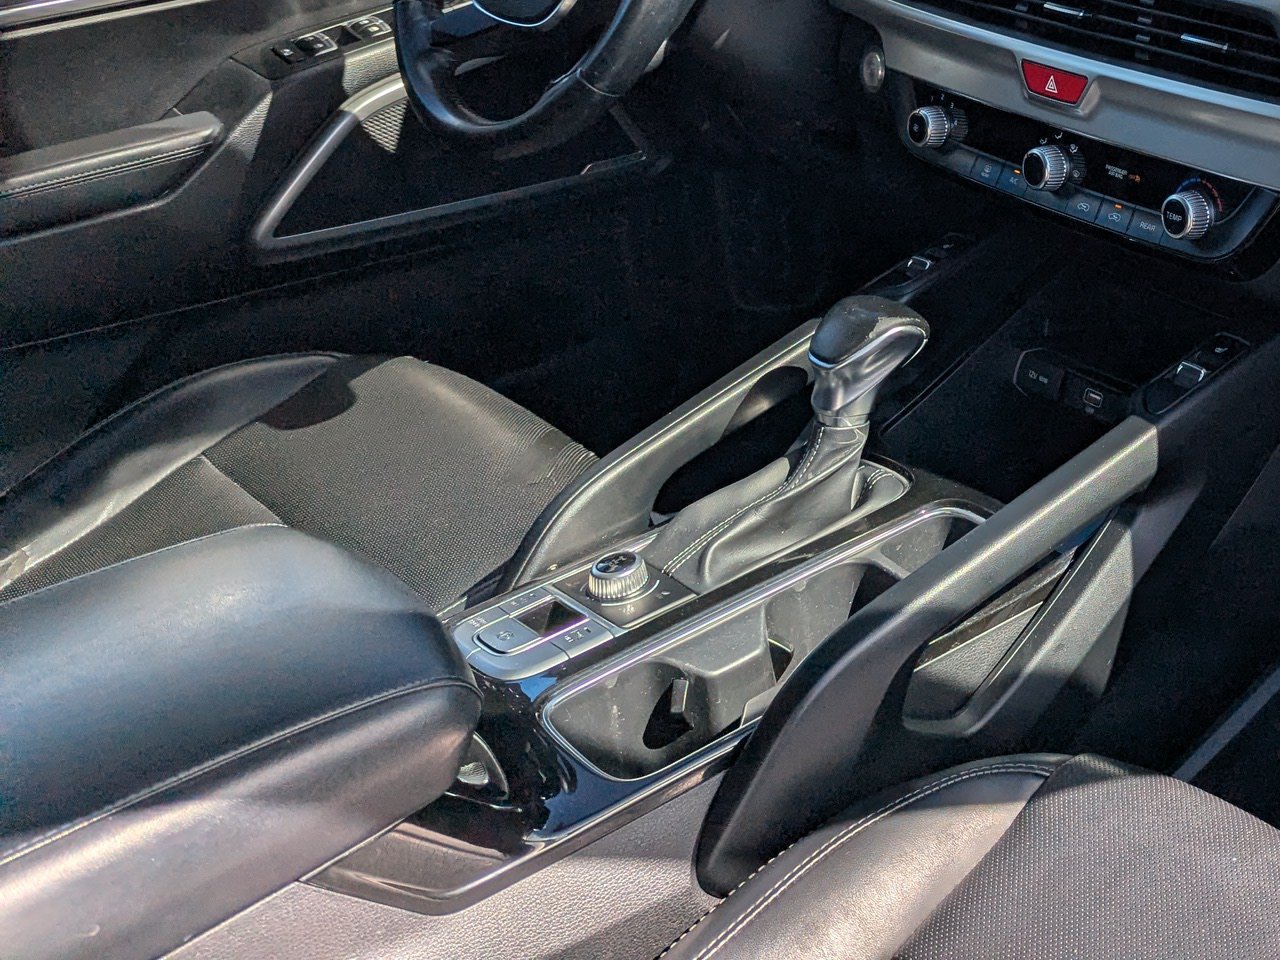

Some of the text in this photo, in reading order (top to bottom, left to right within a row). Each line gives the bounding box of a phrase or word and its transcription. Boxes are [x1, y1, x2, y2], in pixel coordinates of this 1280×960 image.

[1166, 211, 1182, 222] TEMP
[1140, 221, 1156, 232] REAR
[1028, 369, 1038, 380] 12V
